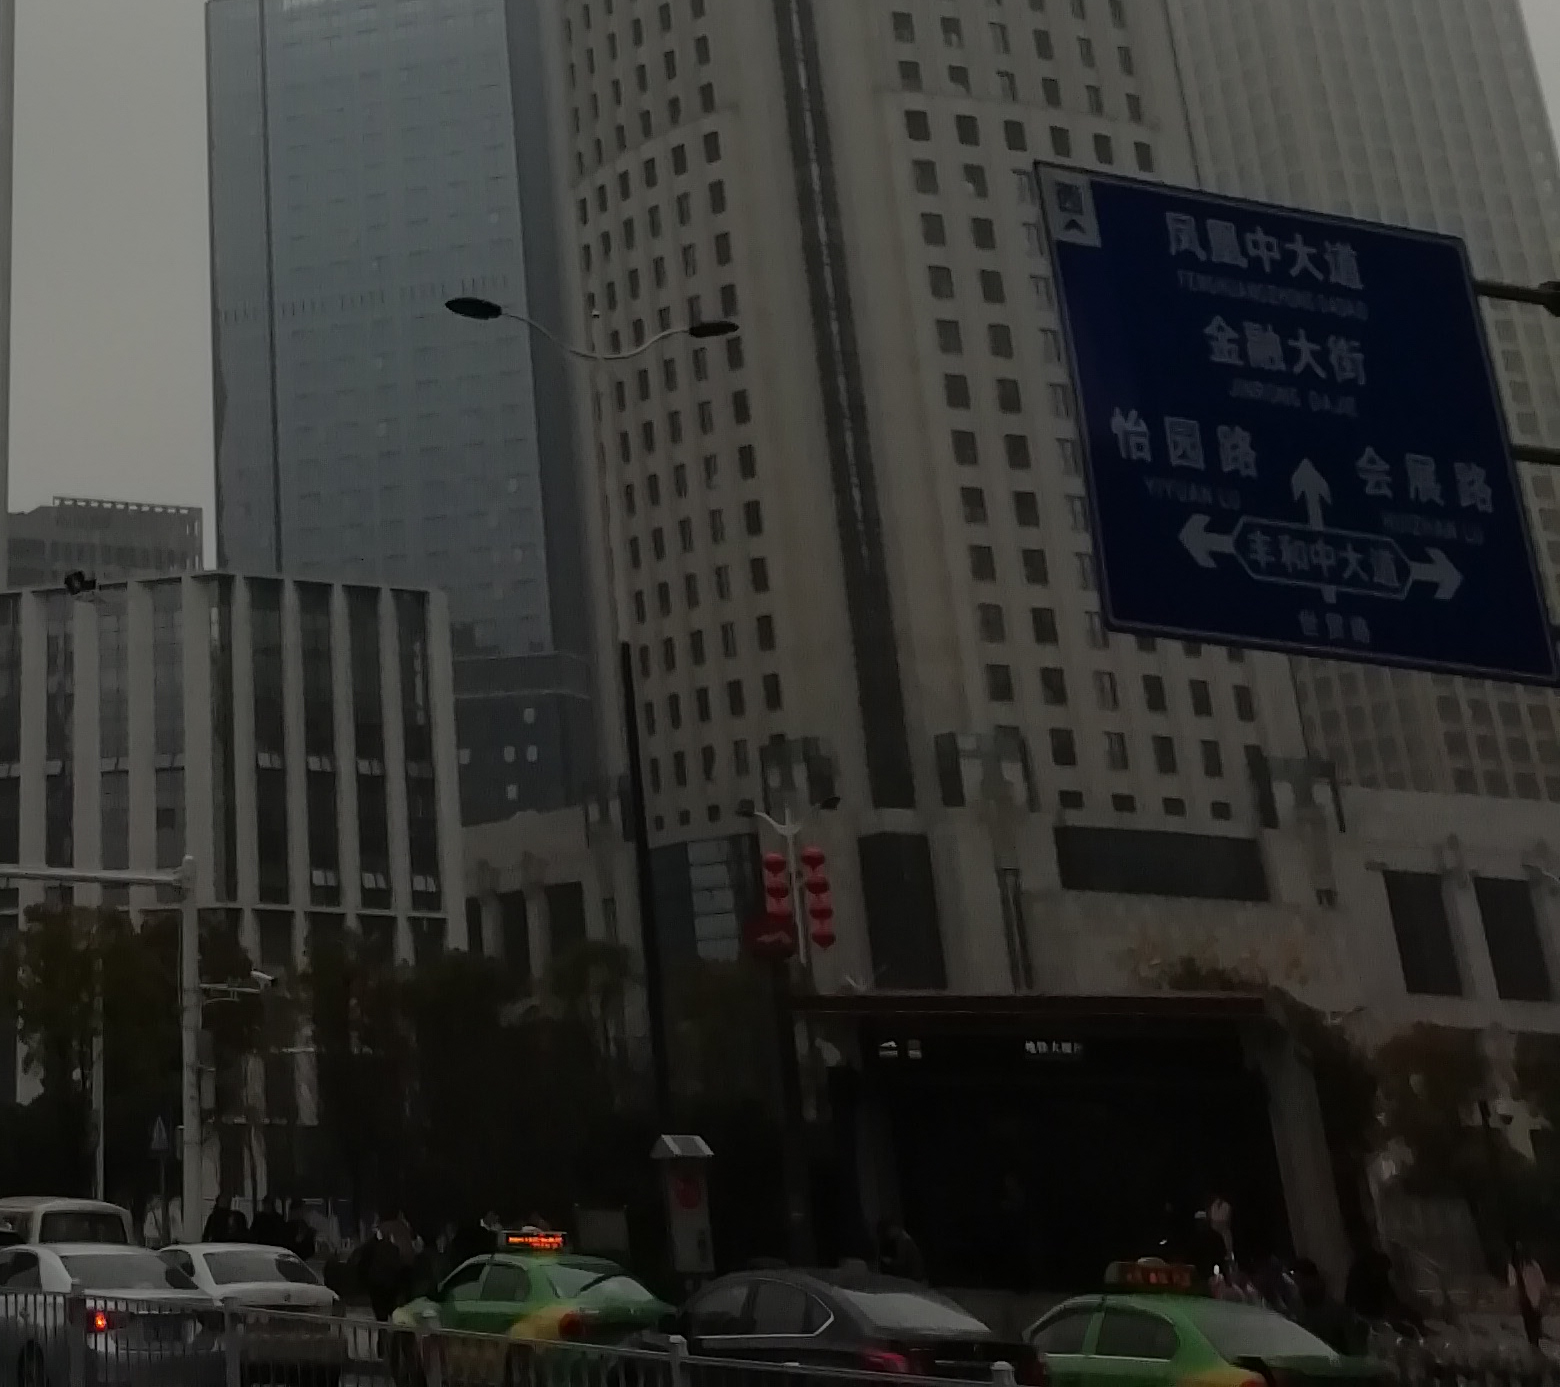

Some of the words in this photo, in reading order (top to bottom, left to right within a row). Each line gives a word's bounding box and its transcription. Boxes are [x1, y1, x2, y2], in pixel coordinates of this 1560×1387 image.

[1165, 211, 1365, 290] 凤凰中大道
[1203, 314, 1367, 386] 金融大街
[1110, 406, 1258, 479] 怡园路
[1355, 445, 1493, 514] 会展路
[1246, 530, 1401, 588] 丰和中大道
